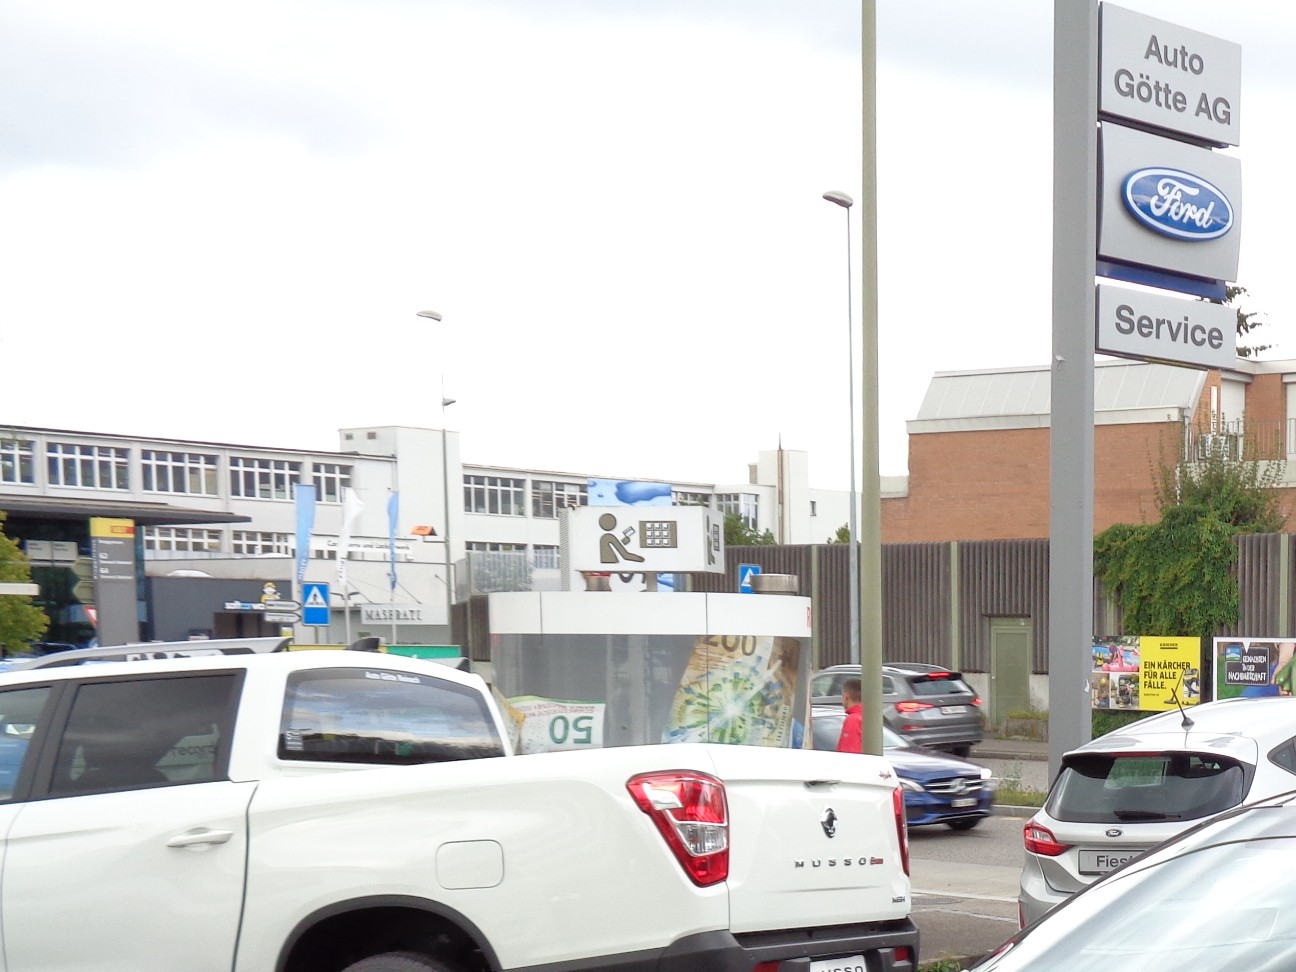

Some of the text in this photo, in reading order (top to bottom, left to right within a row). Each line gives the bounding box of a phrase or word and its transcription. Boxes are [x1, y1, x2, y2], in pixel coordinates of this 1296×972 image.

[1144, 35, 1204, 75] Auto
[1114, 68, 1231, 126] Götte AG
[1150, 177, 1215, 229] Ford
[1115, 304, 1224, 349] Service
[1143, 660, 1191, 670] EIN KÄRCHER
[1143, 670, 1177, 680] FÜR ALLE
[1143, 680, 1167, 690] FÄLLE.
[549, 715, 594, 745] 50
[795, 858, 868, 868] MUSSO
